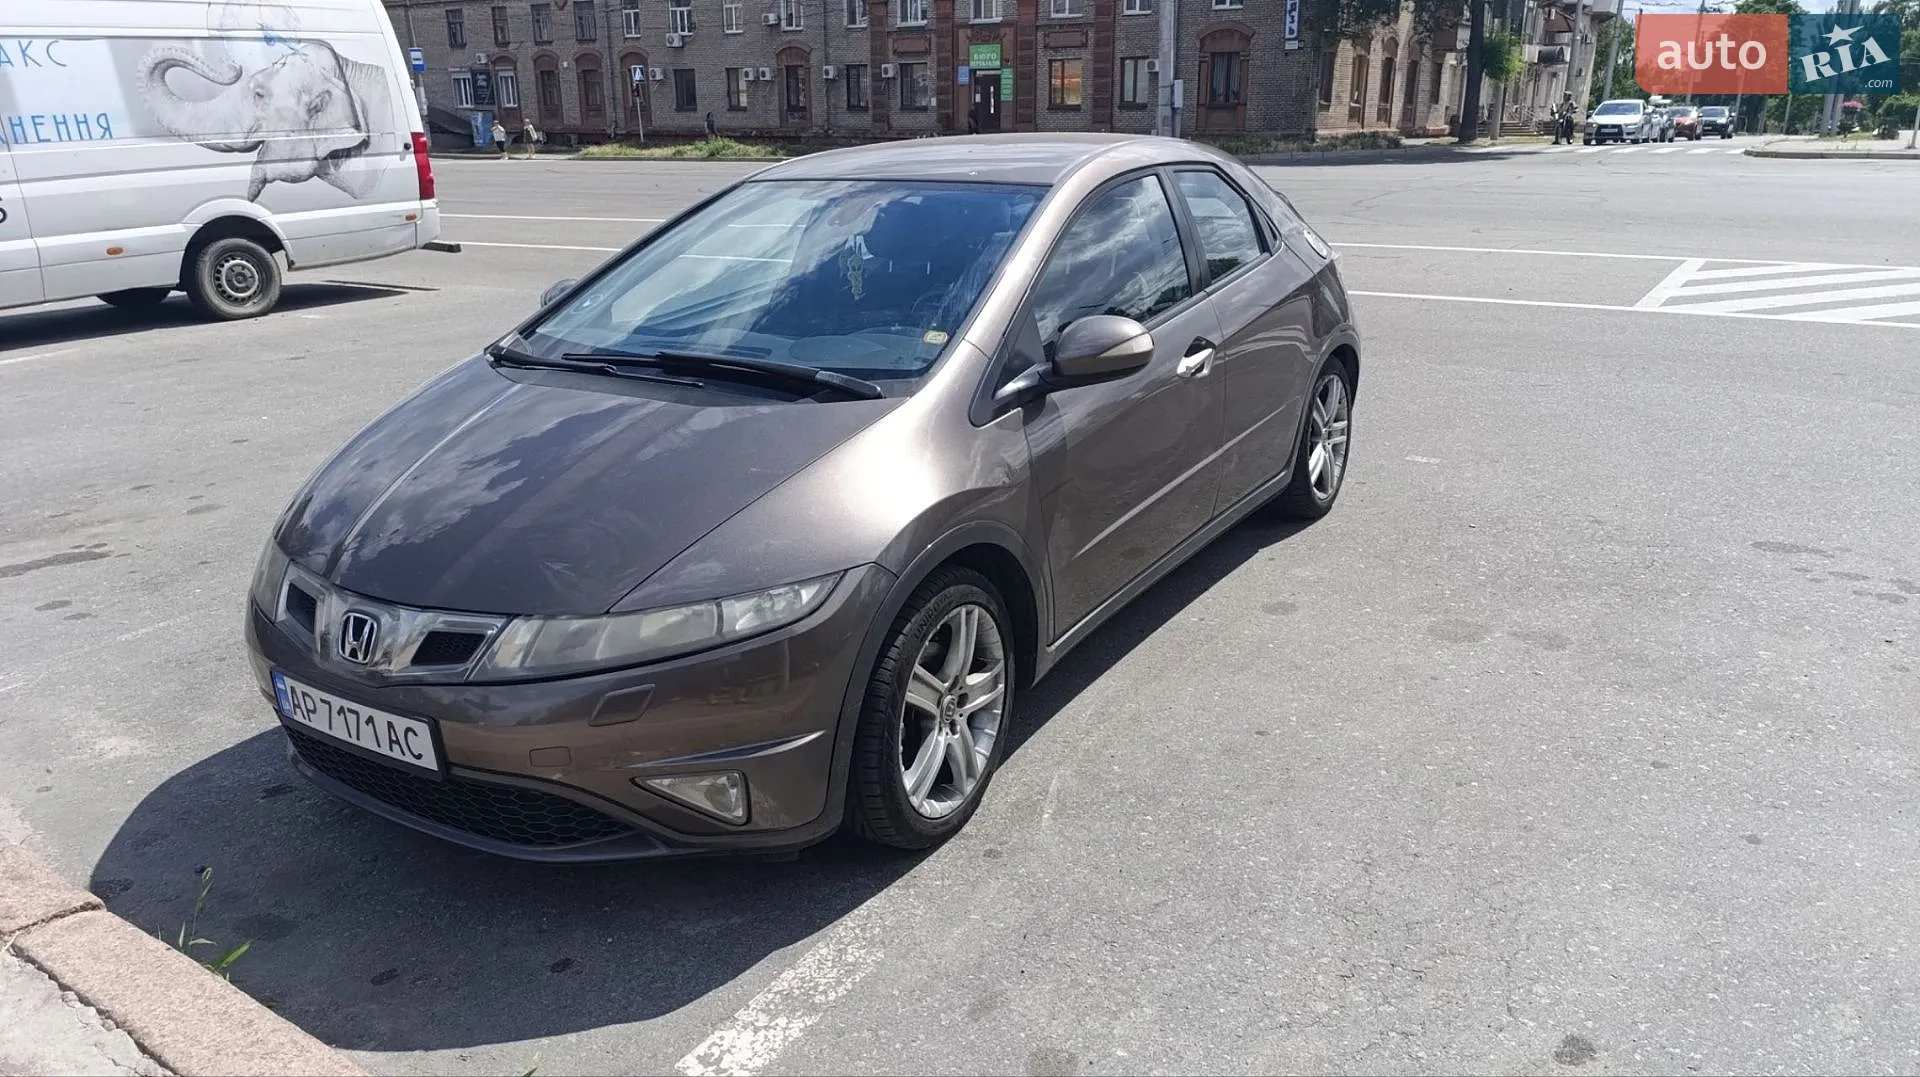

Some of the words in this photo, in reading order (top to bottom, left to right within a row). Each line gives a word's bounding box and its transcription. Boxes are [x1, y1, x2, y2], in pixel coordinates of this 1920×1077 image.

[1288, 0, 1298, 36] ЯЗЬ
[0, 112, 114, 144] НЕННЯ
[290, 685, 317, 722] AP
[319, 697, 381, 748] 7171
[386, 720, 424, 760] AC
